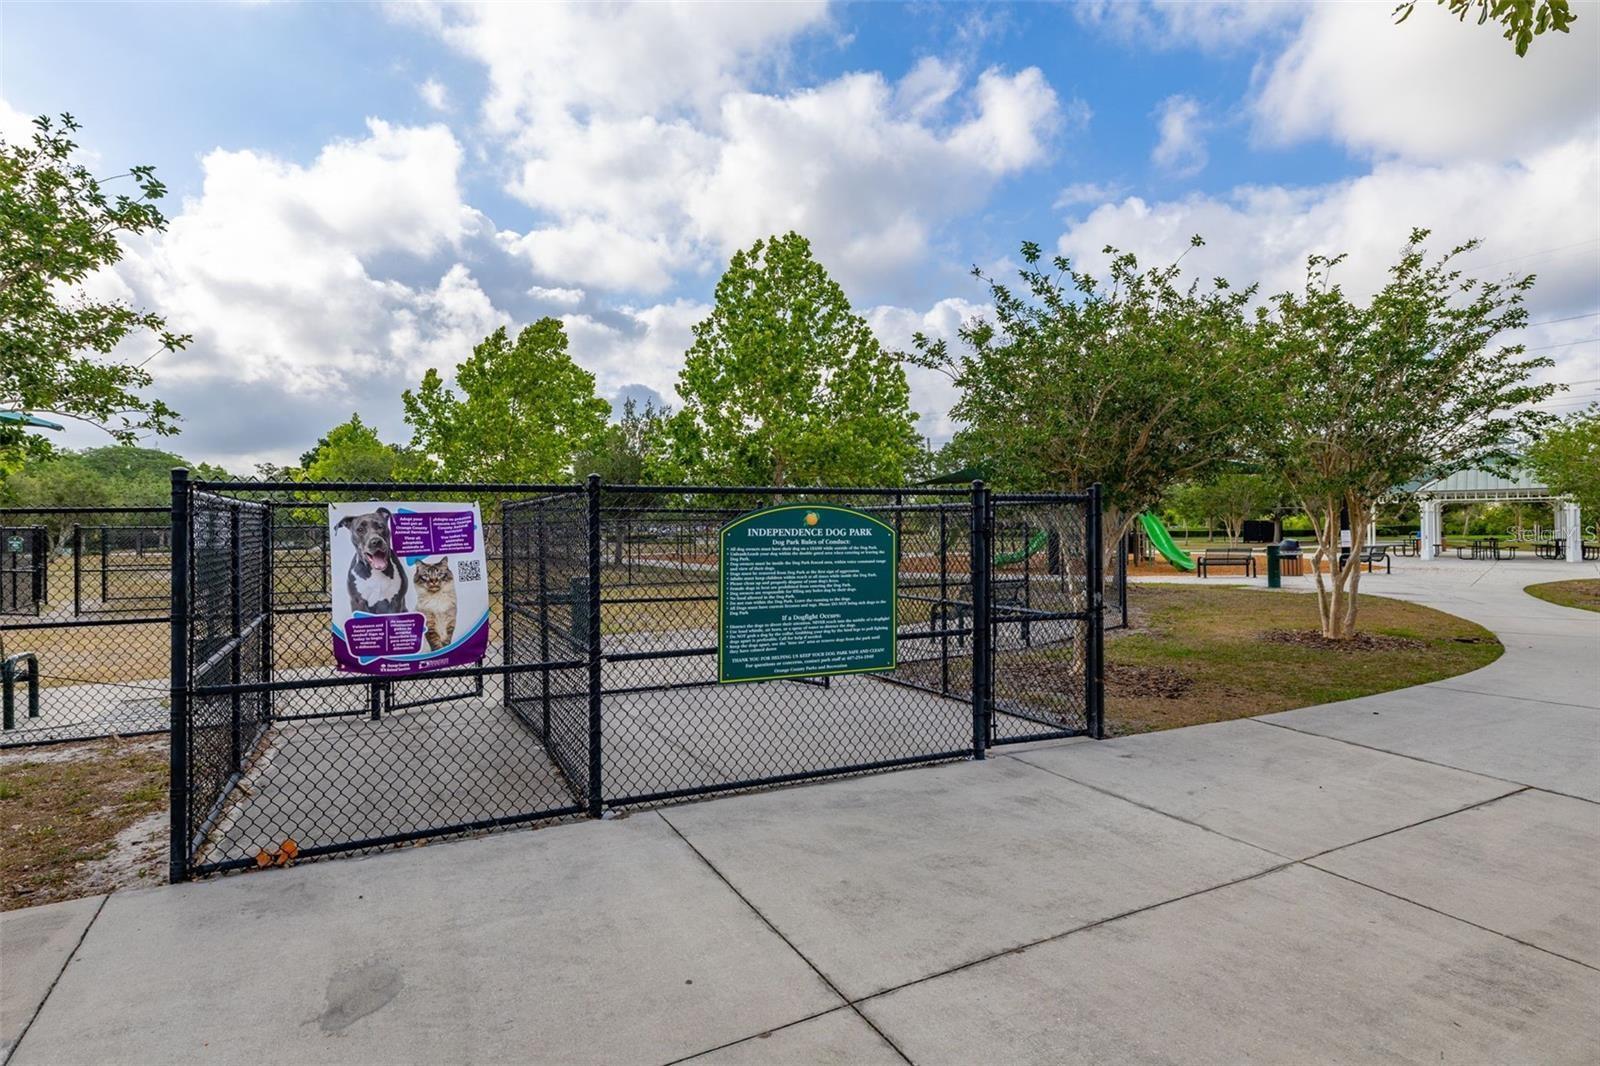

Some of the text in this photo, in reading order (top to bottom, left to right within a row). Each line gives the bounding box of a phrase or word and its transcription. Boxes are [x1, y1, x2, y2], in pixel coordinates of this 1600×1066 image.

[748, 528, 872, 537] INDEPENDENCE DOG PARK
